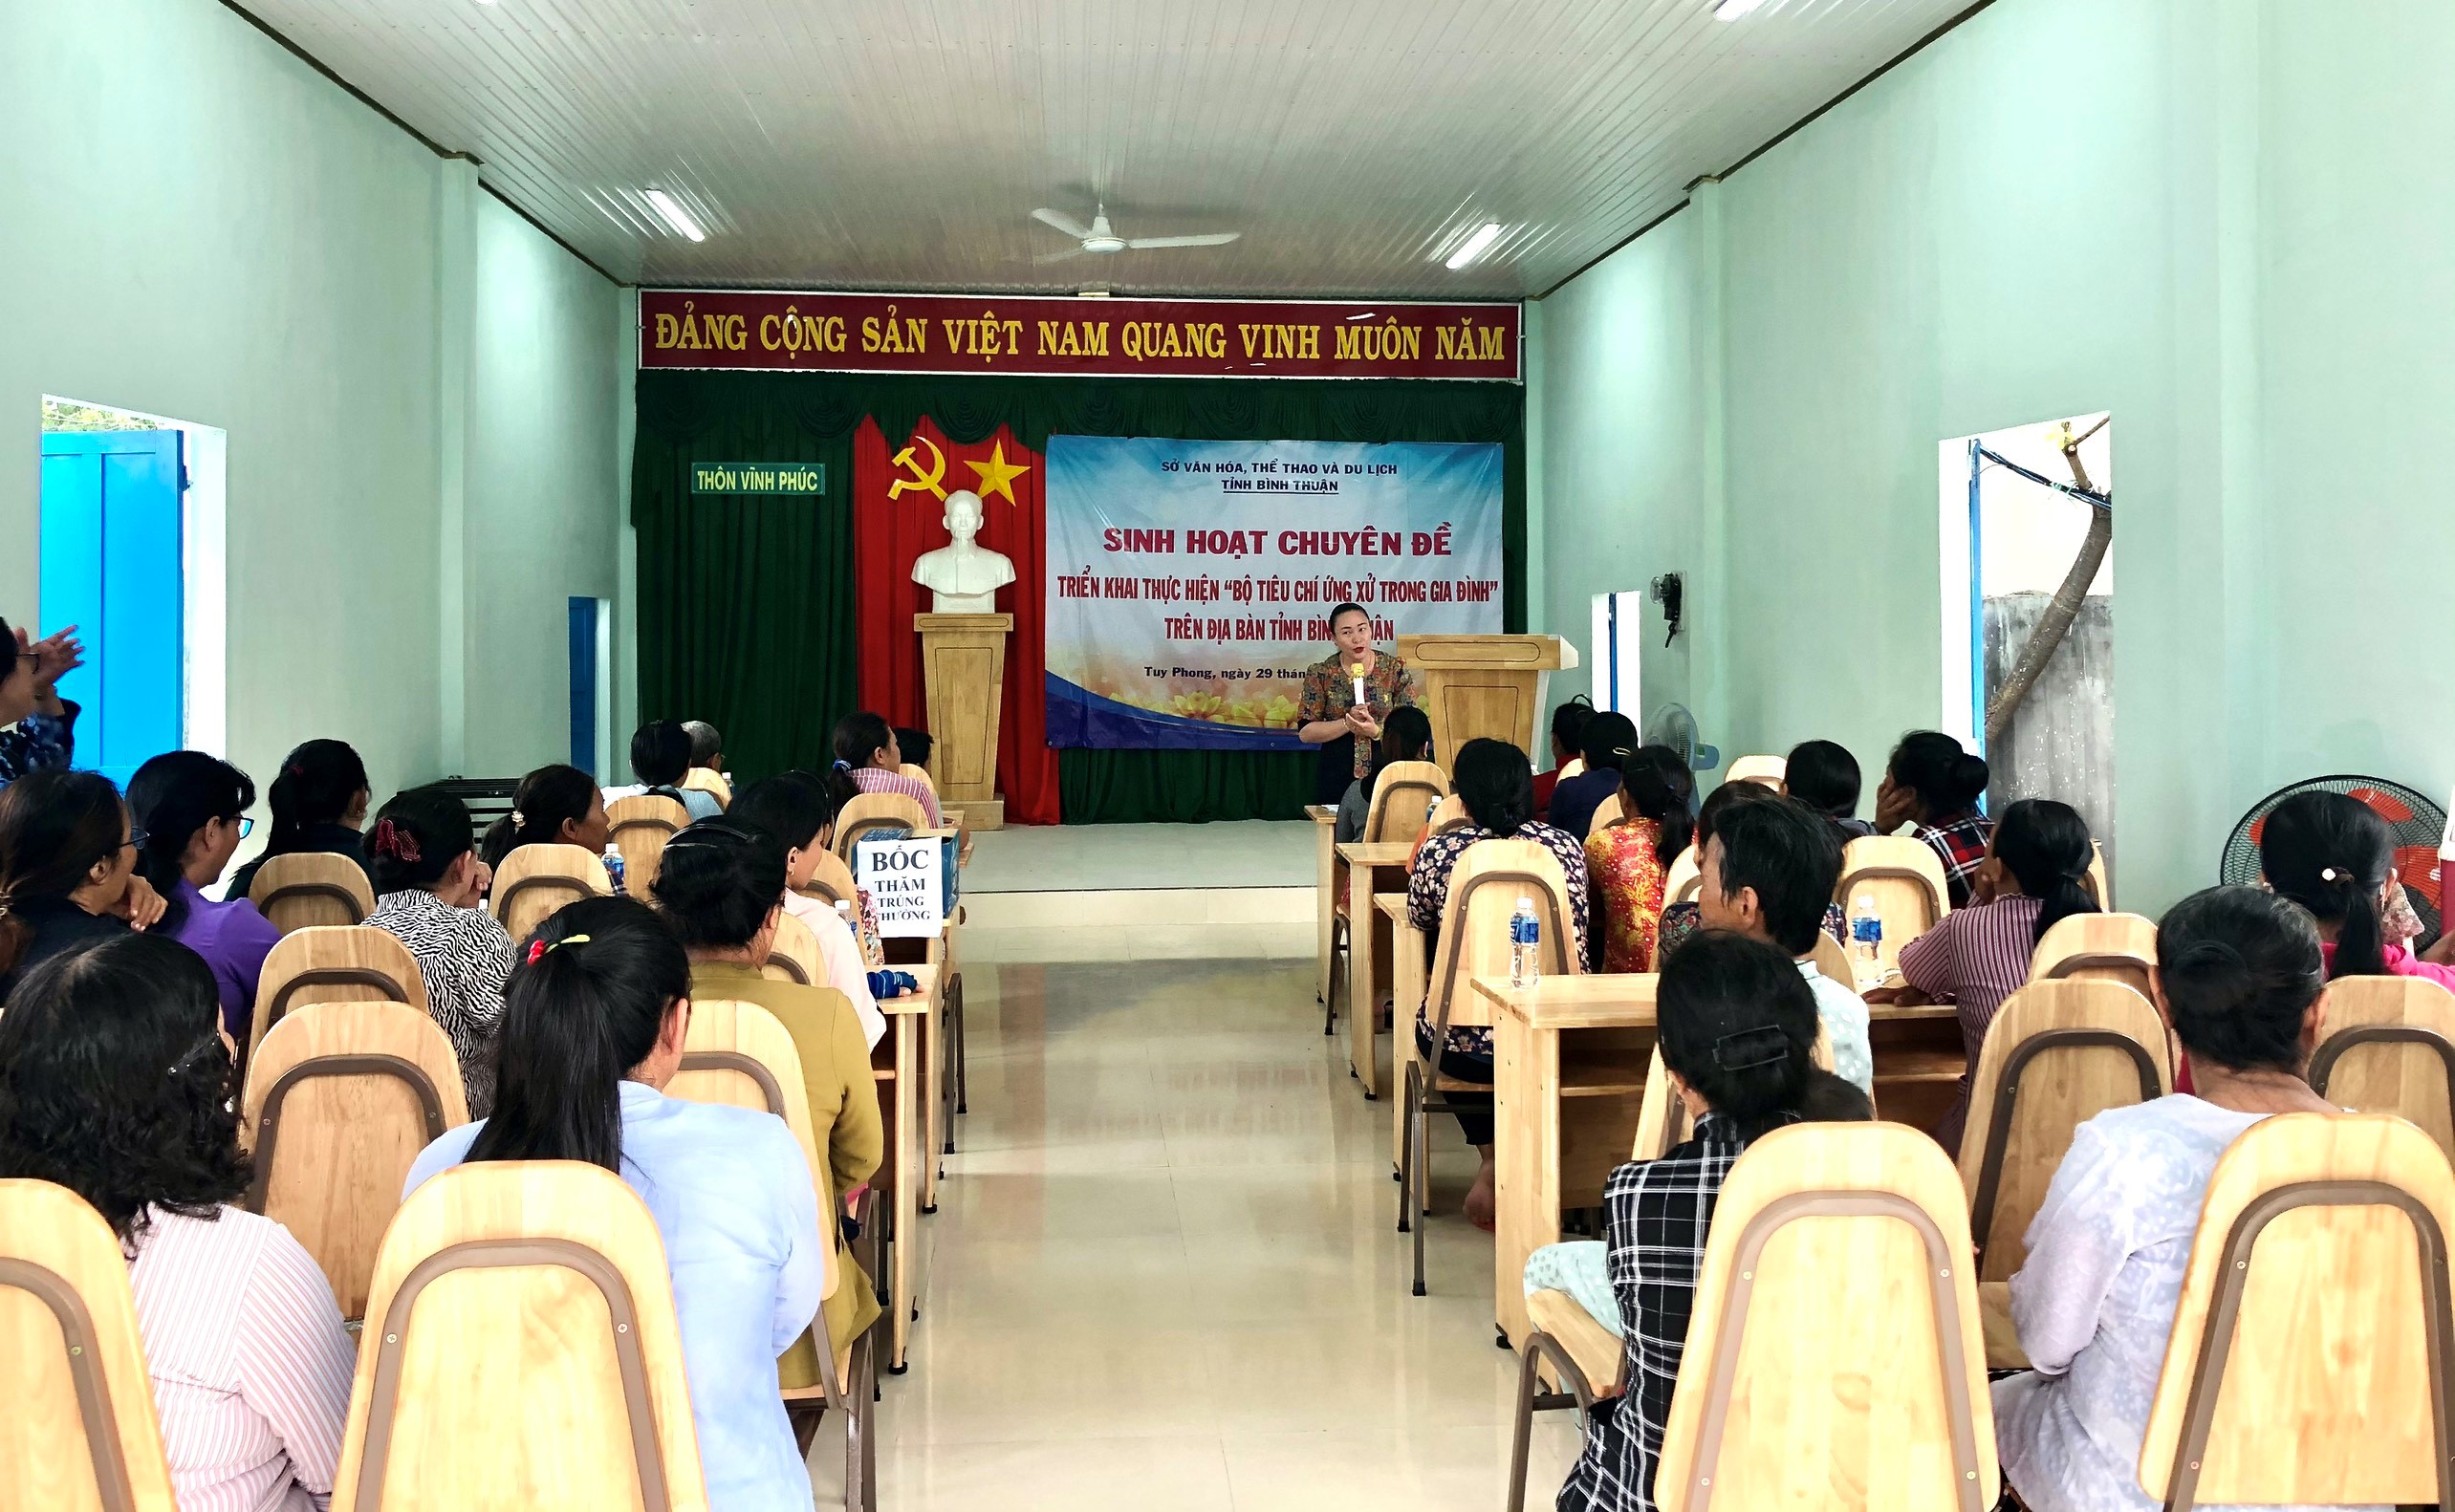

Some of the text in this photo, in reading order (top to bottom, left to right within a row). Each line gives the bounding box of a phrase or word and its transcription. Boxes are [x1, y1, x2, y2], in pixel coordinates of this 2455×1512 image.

[655, 300, 1506, 363] ĐẢNG CỘNG SẢN VIỆT NAM QUANG VINH MUÔN NĂM
[697, 465, 818, 491] THÔN VĨNH PHÚC
[1162, 458, 1398, 476] SỞ VĂN HÓA, THỂ THAO VÀ DU LỊCH
[1222, 476, 1338, 493] TỈNH BÌNH THUẬN
[1102, 521, 1453, 560] SINH HOẠT CHUYÊN ĐỀ
[1057, 564, 1499, 606] TRIỂN KHAI THỰC HIỆN “BỘ TIÊU CHÍ ỨNG XỬ TRONG GIA ĐÌNH”
[1164, 611, 1332, 645] TRÊN ĐỊA BÀN TỈNH BÌN
[1144, 666, 1309, 680] Tuy Phong, ngày 29 thán
[872, 845, 929, 872] BỐC
[875, 875, 925, 893] THĂM
[878, 895, 924, 908] TRÚNG
[877, 909, 931, 921] HƯỞNG
